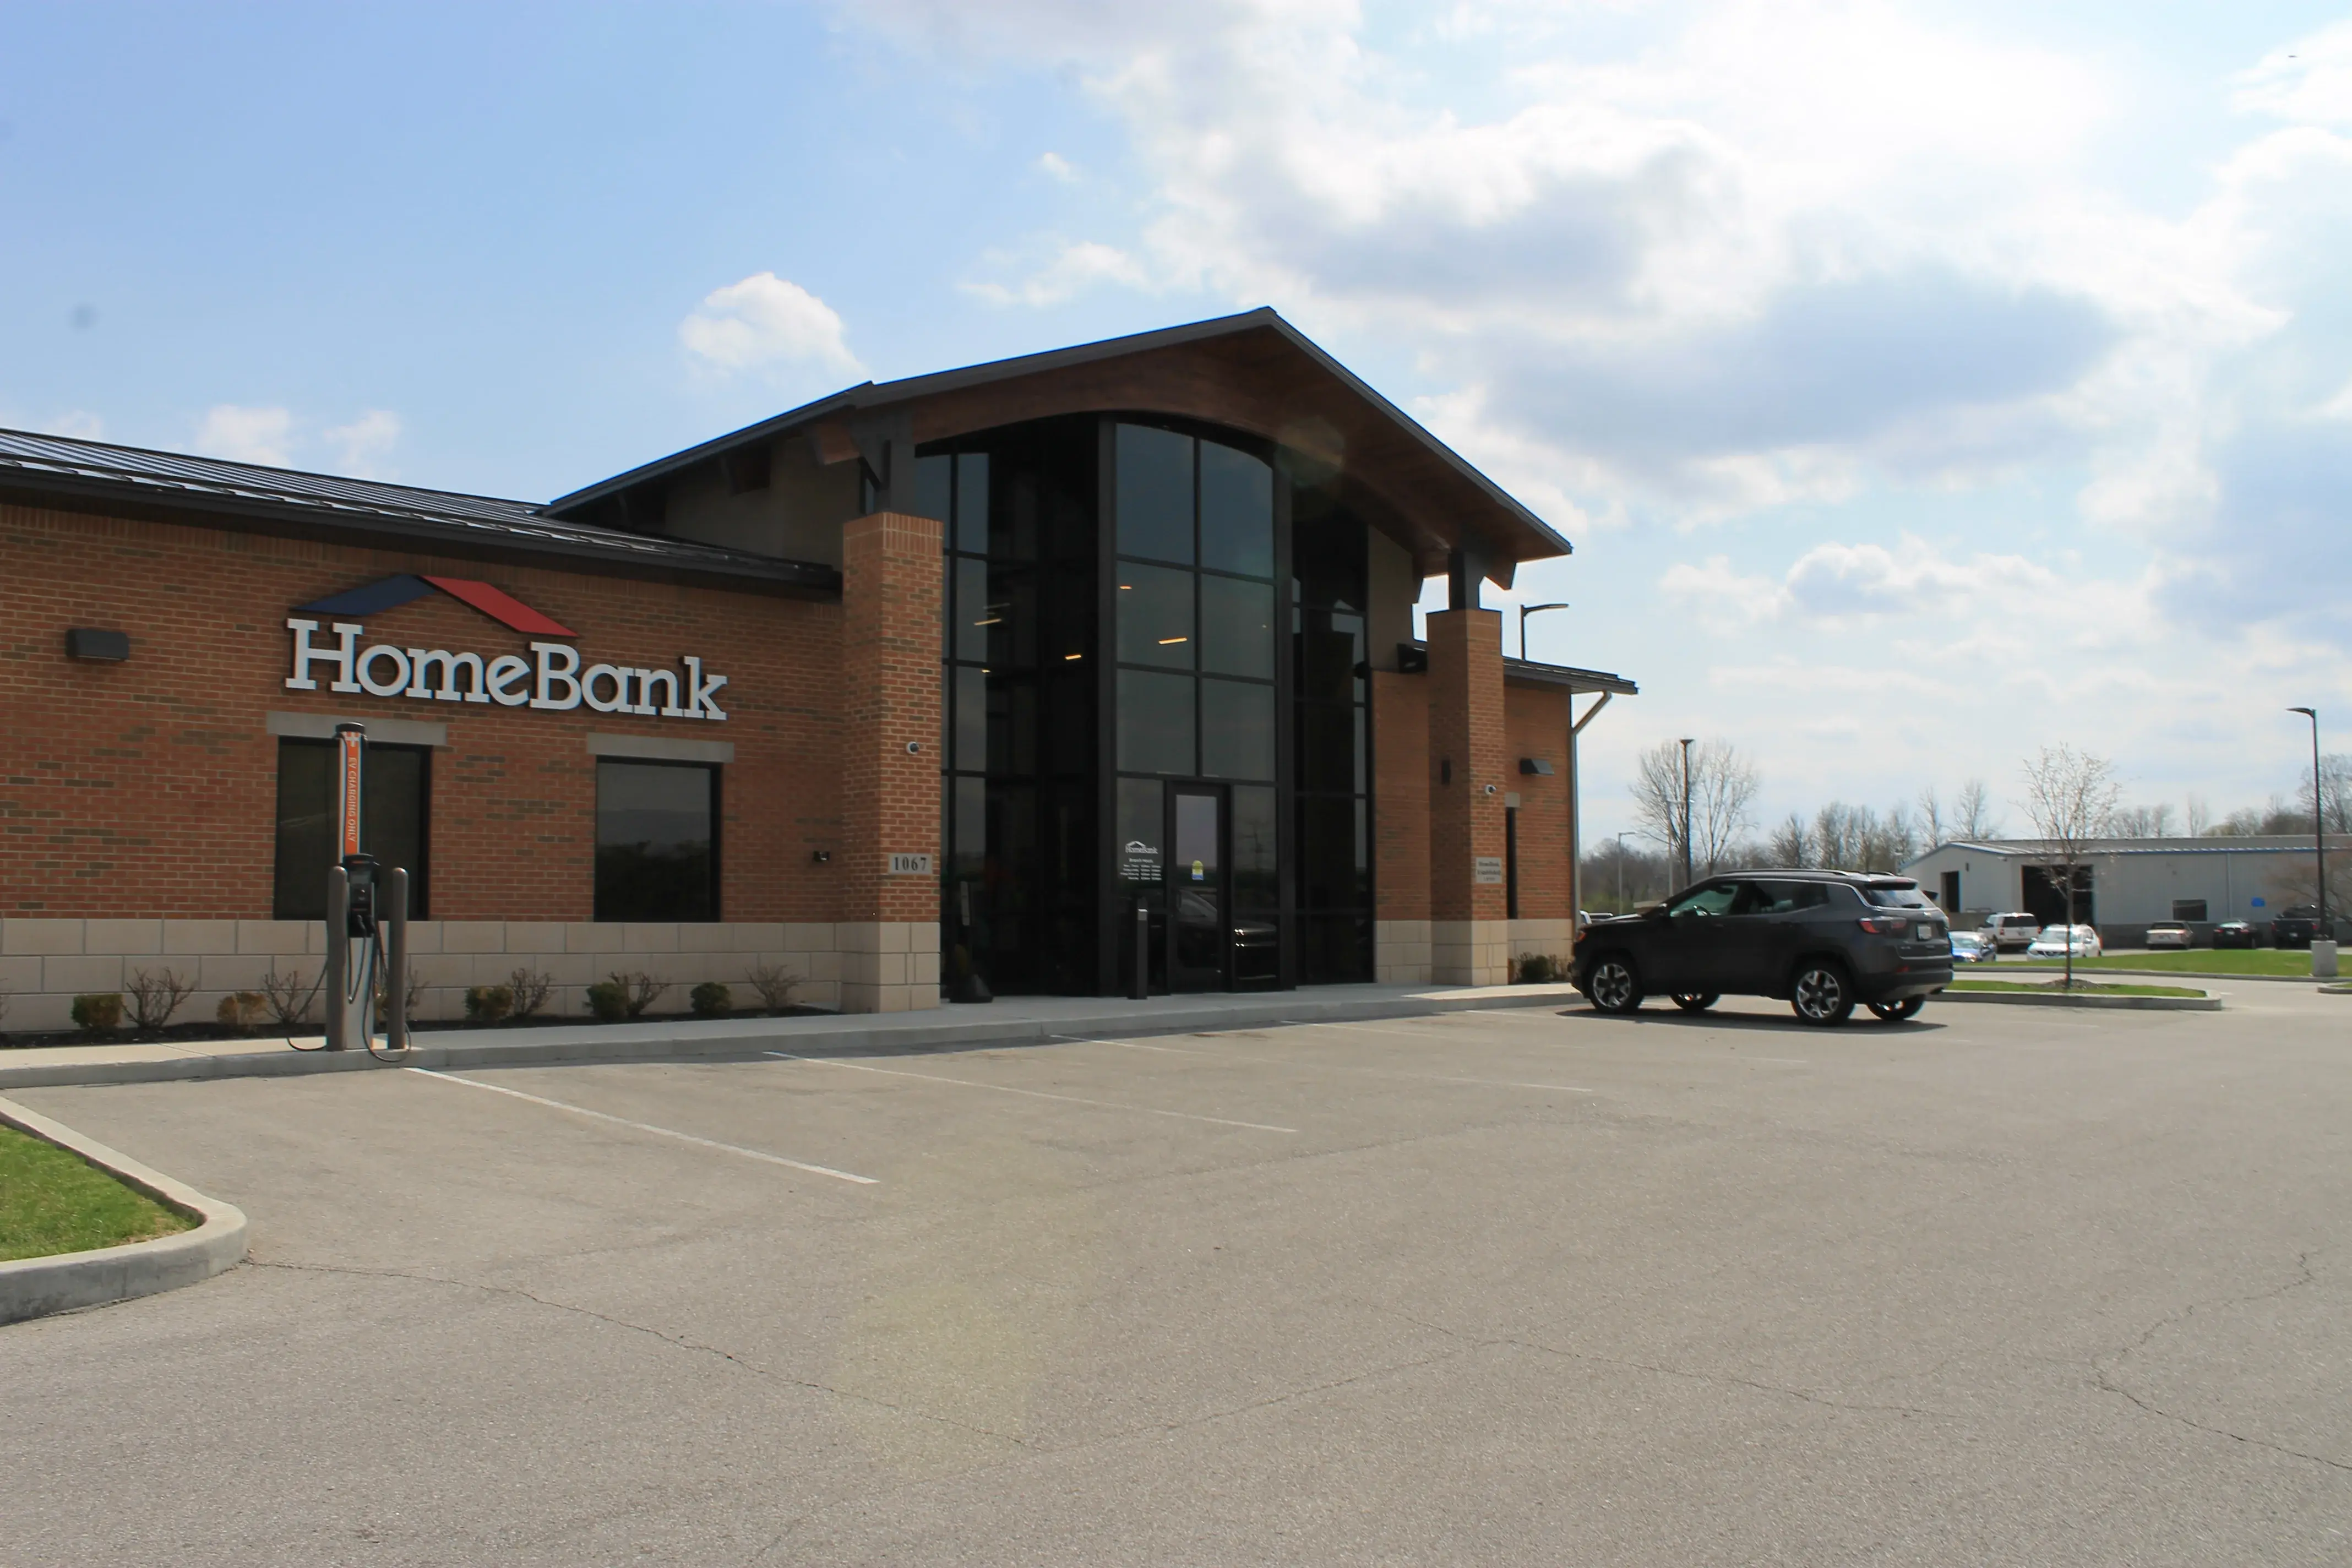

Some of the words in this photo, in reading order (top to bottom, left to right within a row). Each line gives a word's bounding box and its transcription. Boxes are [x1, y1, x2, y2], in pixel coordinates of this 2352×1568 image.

[285, 618, 727, 721] HomeBank
[347, 756, 357, 769] EV
[347, 771, 357, 817] CHARGING
[347, 819, 357, 842] ONLY
[894, 856, 927, 870] 1067
